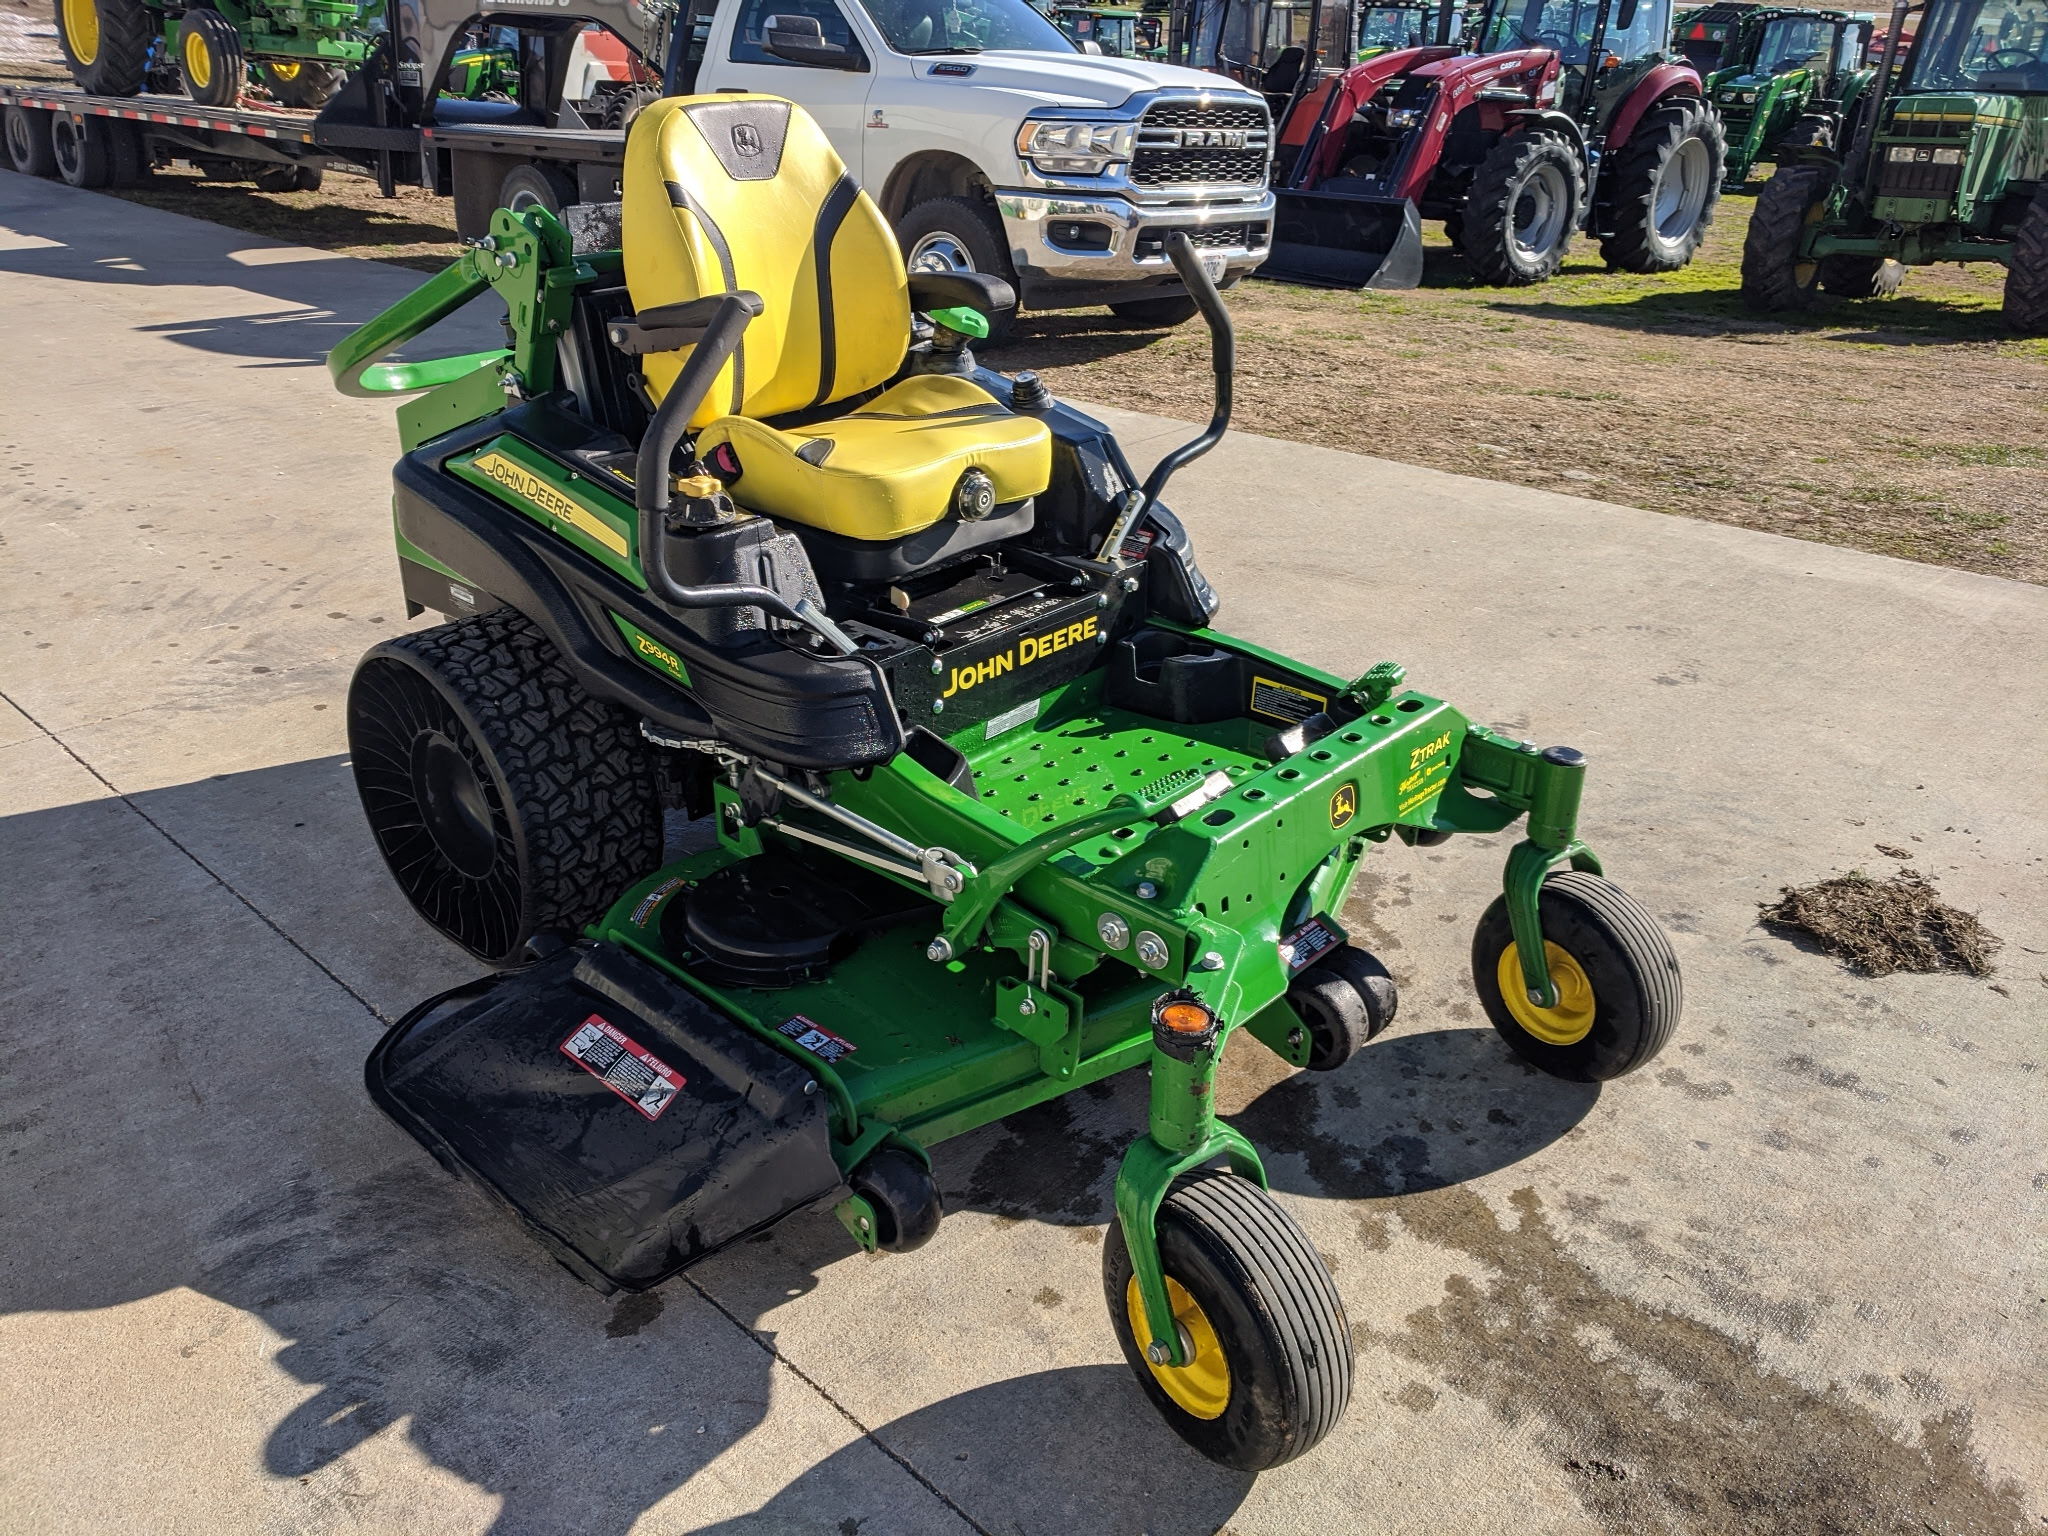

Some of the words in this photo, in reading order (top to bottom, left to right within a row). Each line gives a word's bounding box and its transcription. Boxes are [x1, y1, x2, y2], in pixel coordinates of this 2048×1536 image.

[1185, 131, 1246, 147] RAM
[487, 457, 525, 494] JOHN
[526, 478, 574, 521] DEERE
[636, 635, 680, 671] Z994R
[943, 650, 1013, 698] JOHN
[1019, 615, 1098, 666] DEERE
[1410, 731, 1451, 770] ZTRAK
[604, 1025, 628, 1045] DANGER
